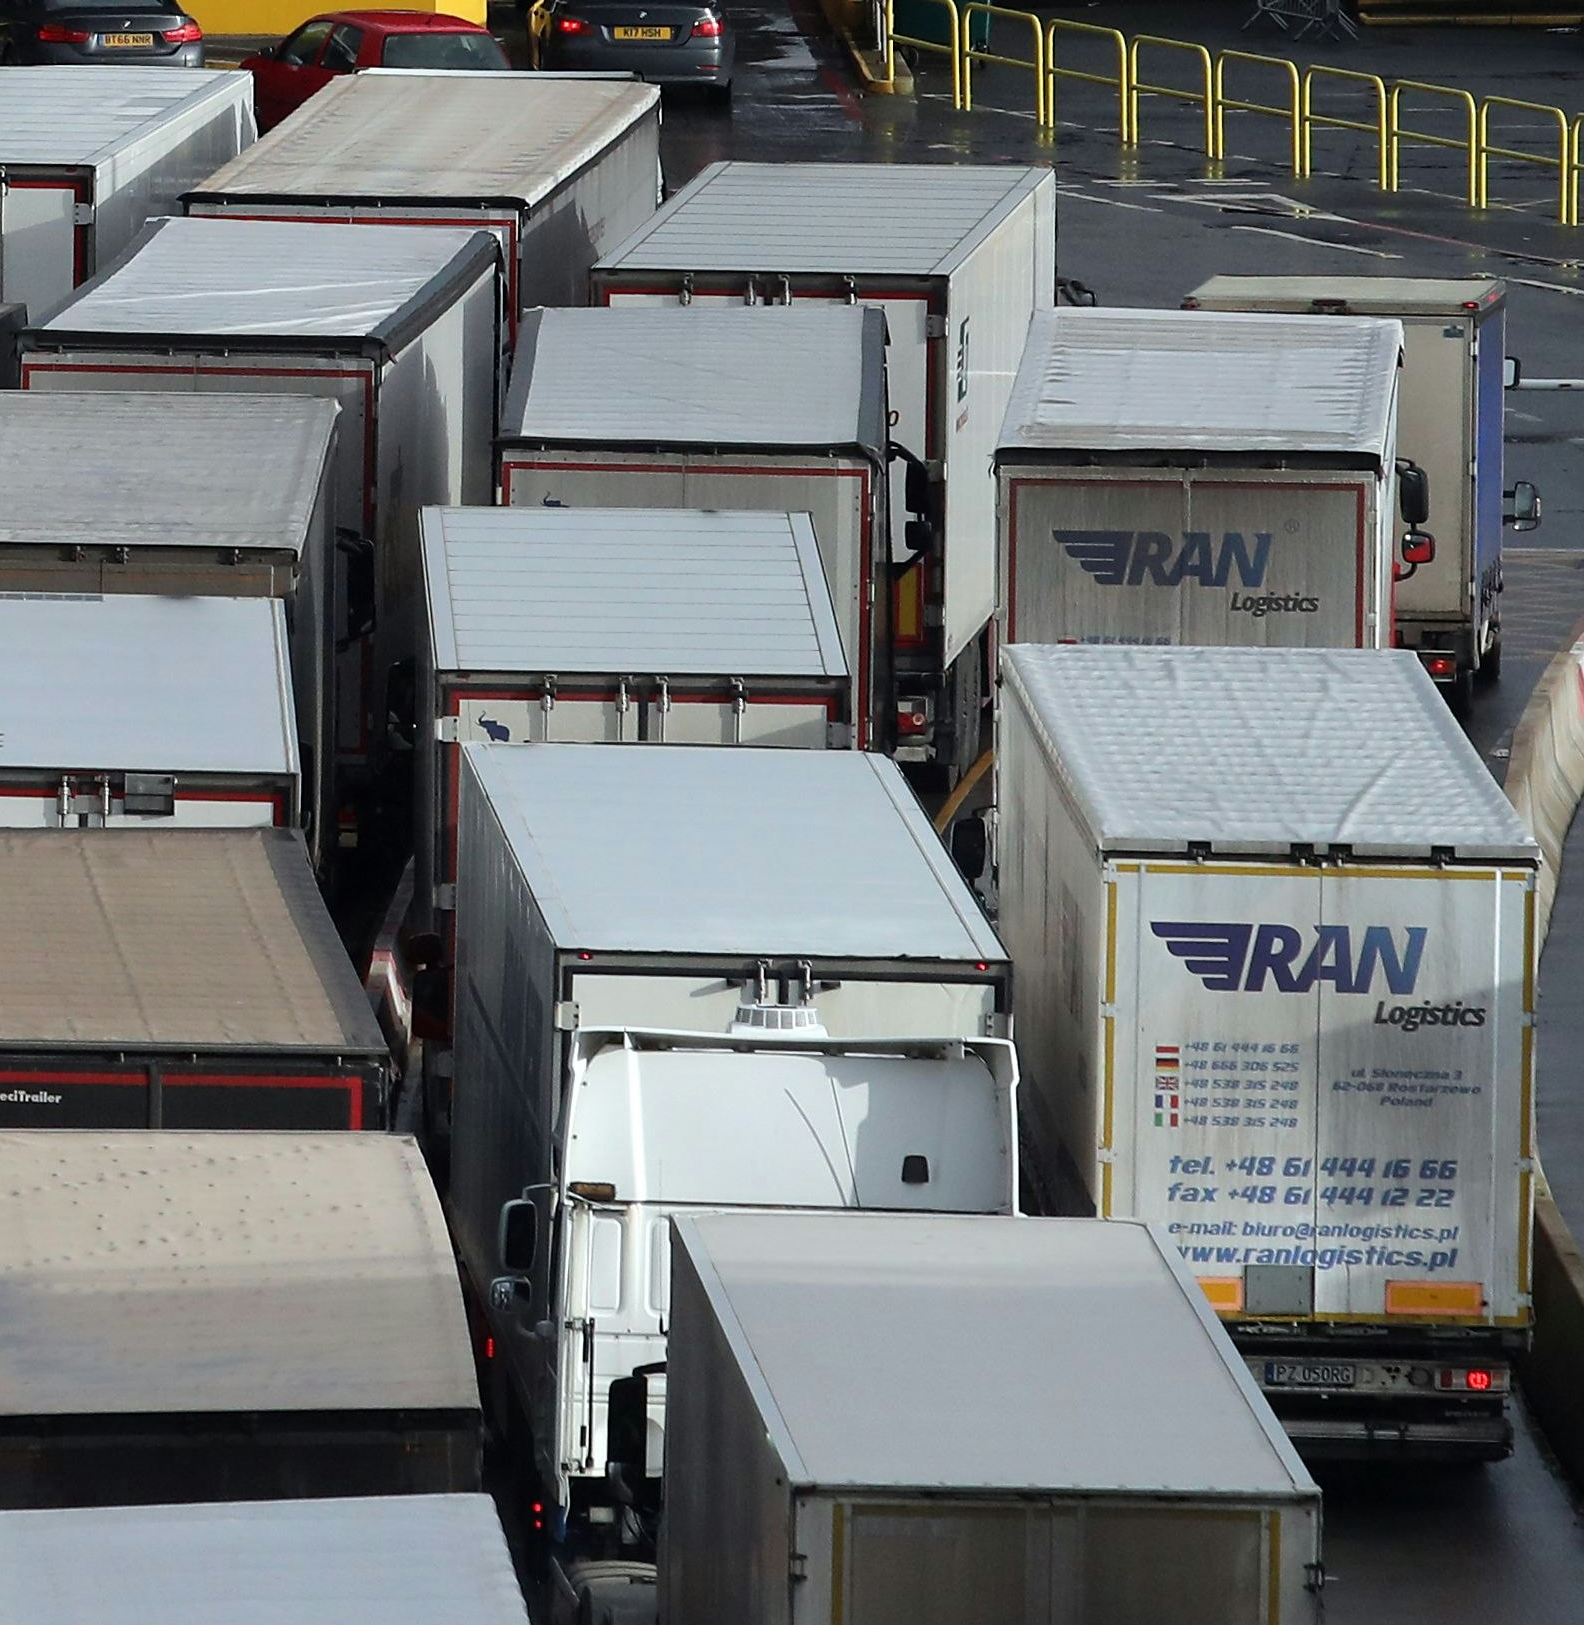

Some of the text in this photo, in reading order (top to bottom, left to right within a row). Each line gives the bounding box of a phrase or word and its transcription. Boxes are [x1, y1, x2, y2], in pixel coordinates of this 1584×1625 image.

[1231, 592, 1320, 617] Logistics
[1374, 1000, 1486, 1031] Logistics
[1185, 1042, 1209, 1051] +48
[1184, 1060, 1208, 1070] +48
[1184, 1079, 1209, 1089] +48
[1183, 1098, 1209, 1107] +48
[1380, 1096, 1433, 1107] Poland
[1183, 1116, 1208, 1126] +48
[1169, 1156, 1457, 1180] tel. +48 61 444 16 66
[1168, 1182, 1455, 1208] fax +48 61 444 12 22
[1168, 1221, 1459, 1242] e-mail: biuro@ranlogistics.pl
[1275, 1367, 1295, 1383] PZ
